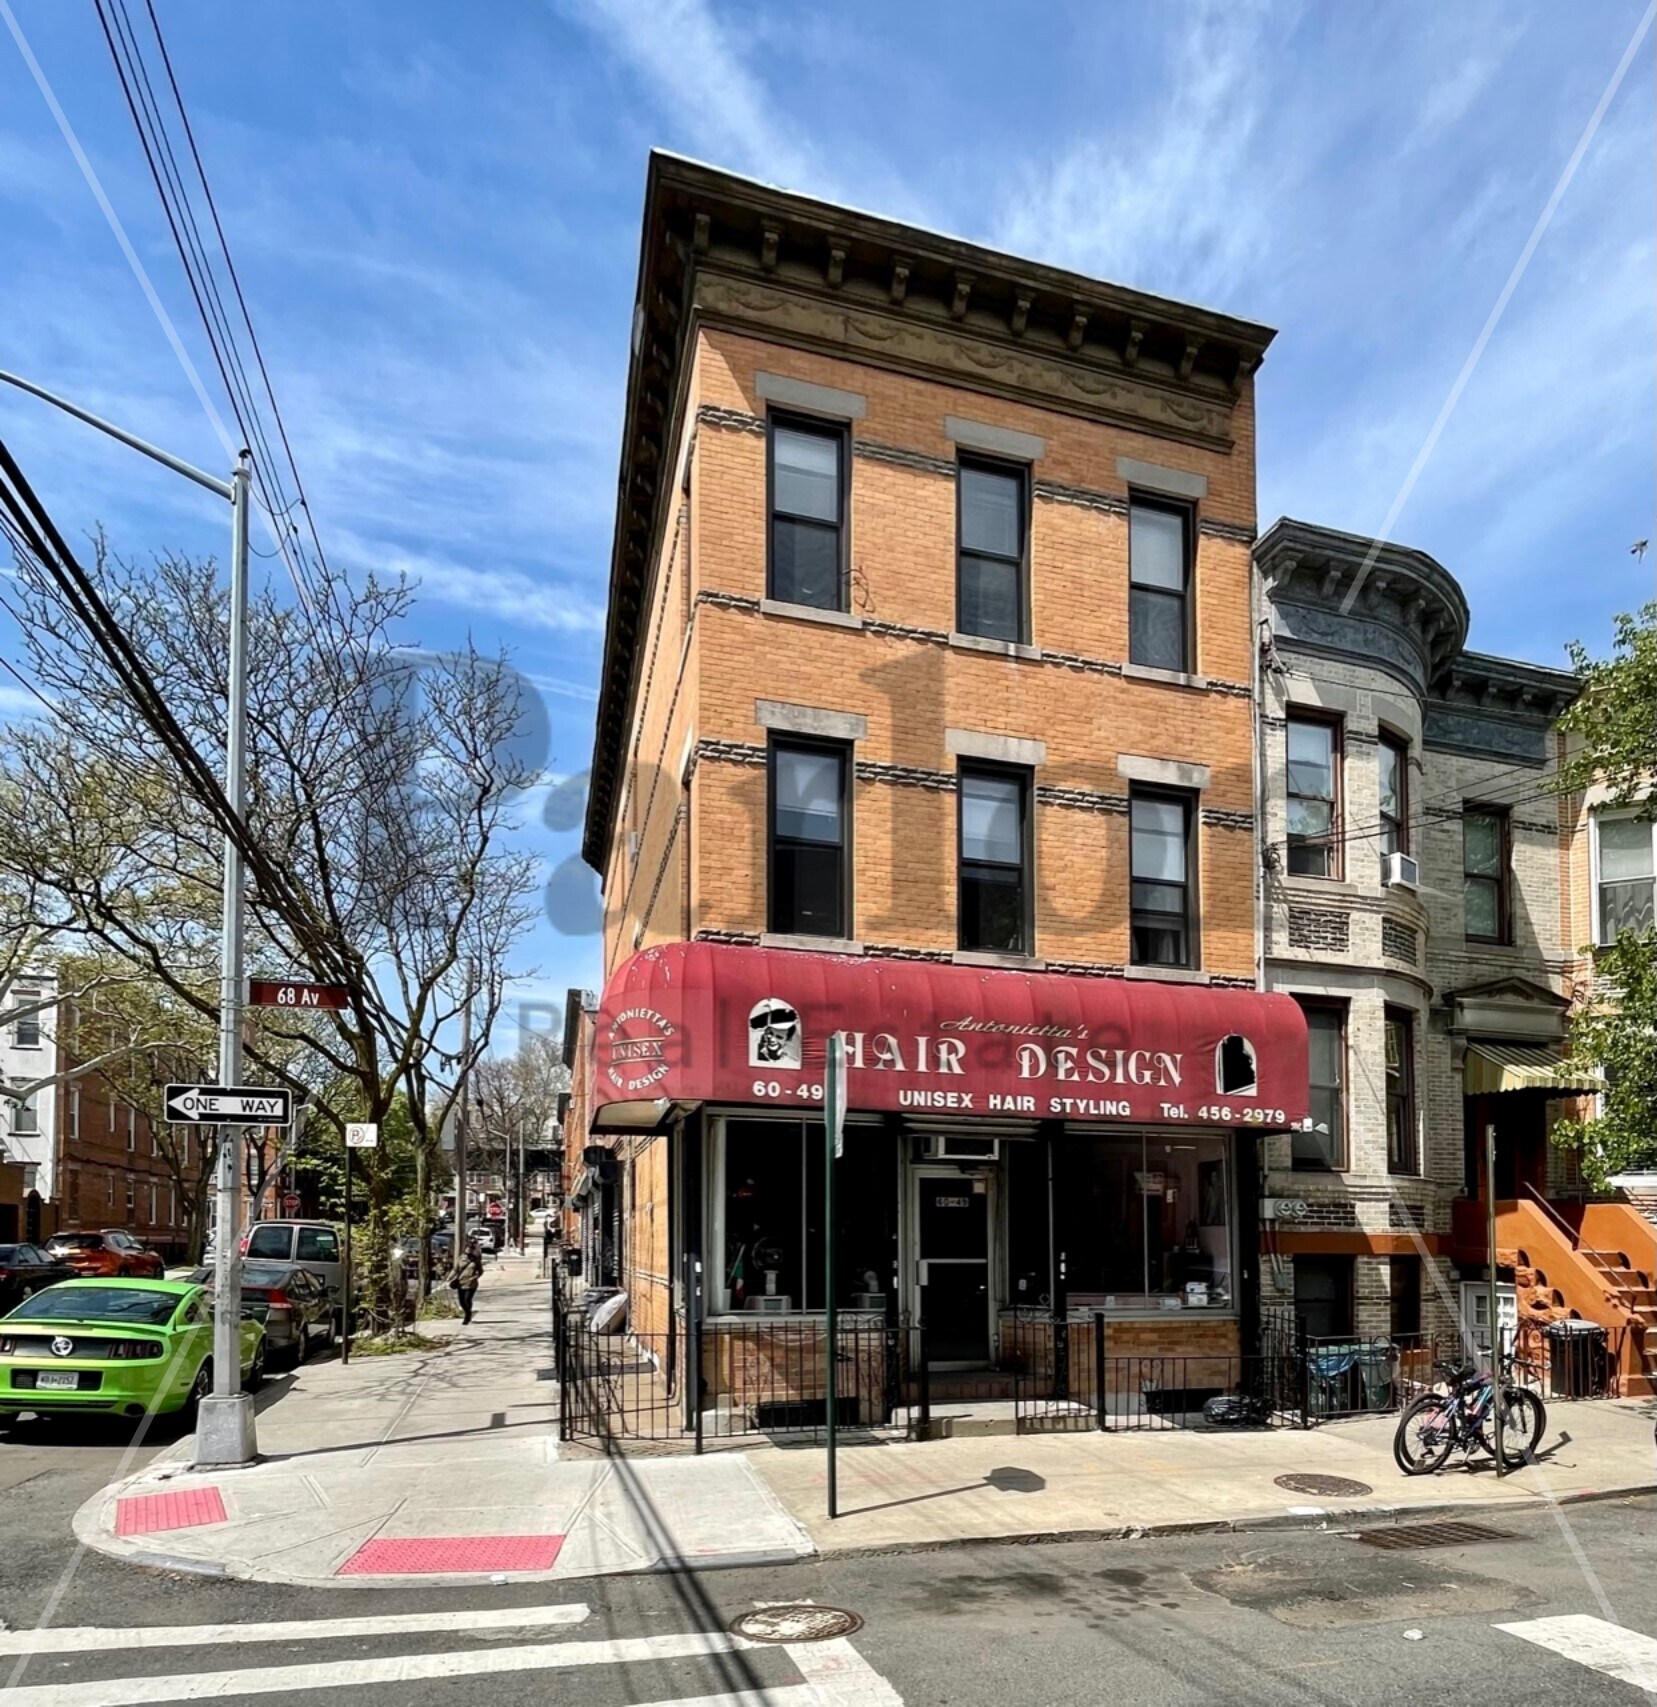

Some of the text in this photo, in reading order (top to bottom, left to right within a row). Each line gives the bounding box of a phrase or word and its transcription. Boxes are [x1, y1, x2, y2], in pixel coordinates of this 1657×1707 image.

[277, 987, 320, 1006] 68 Av
[939, 1015, 1089, 1040] Antonietta's
[611, 1042, 664, 1060] UNISEX
[841, 1031, 1184, 1088] HAIR DESIGN
[607, 1064, 671, 1091] HAIR DESIGN
[182, 1096, 280, 1114] ONE WAY
[898, 1090, 1131, 1117] UNISEX HAIR STYLING
[1160, 1102, 1286, 1124] Tel. 456-2979
